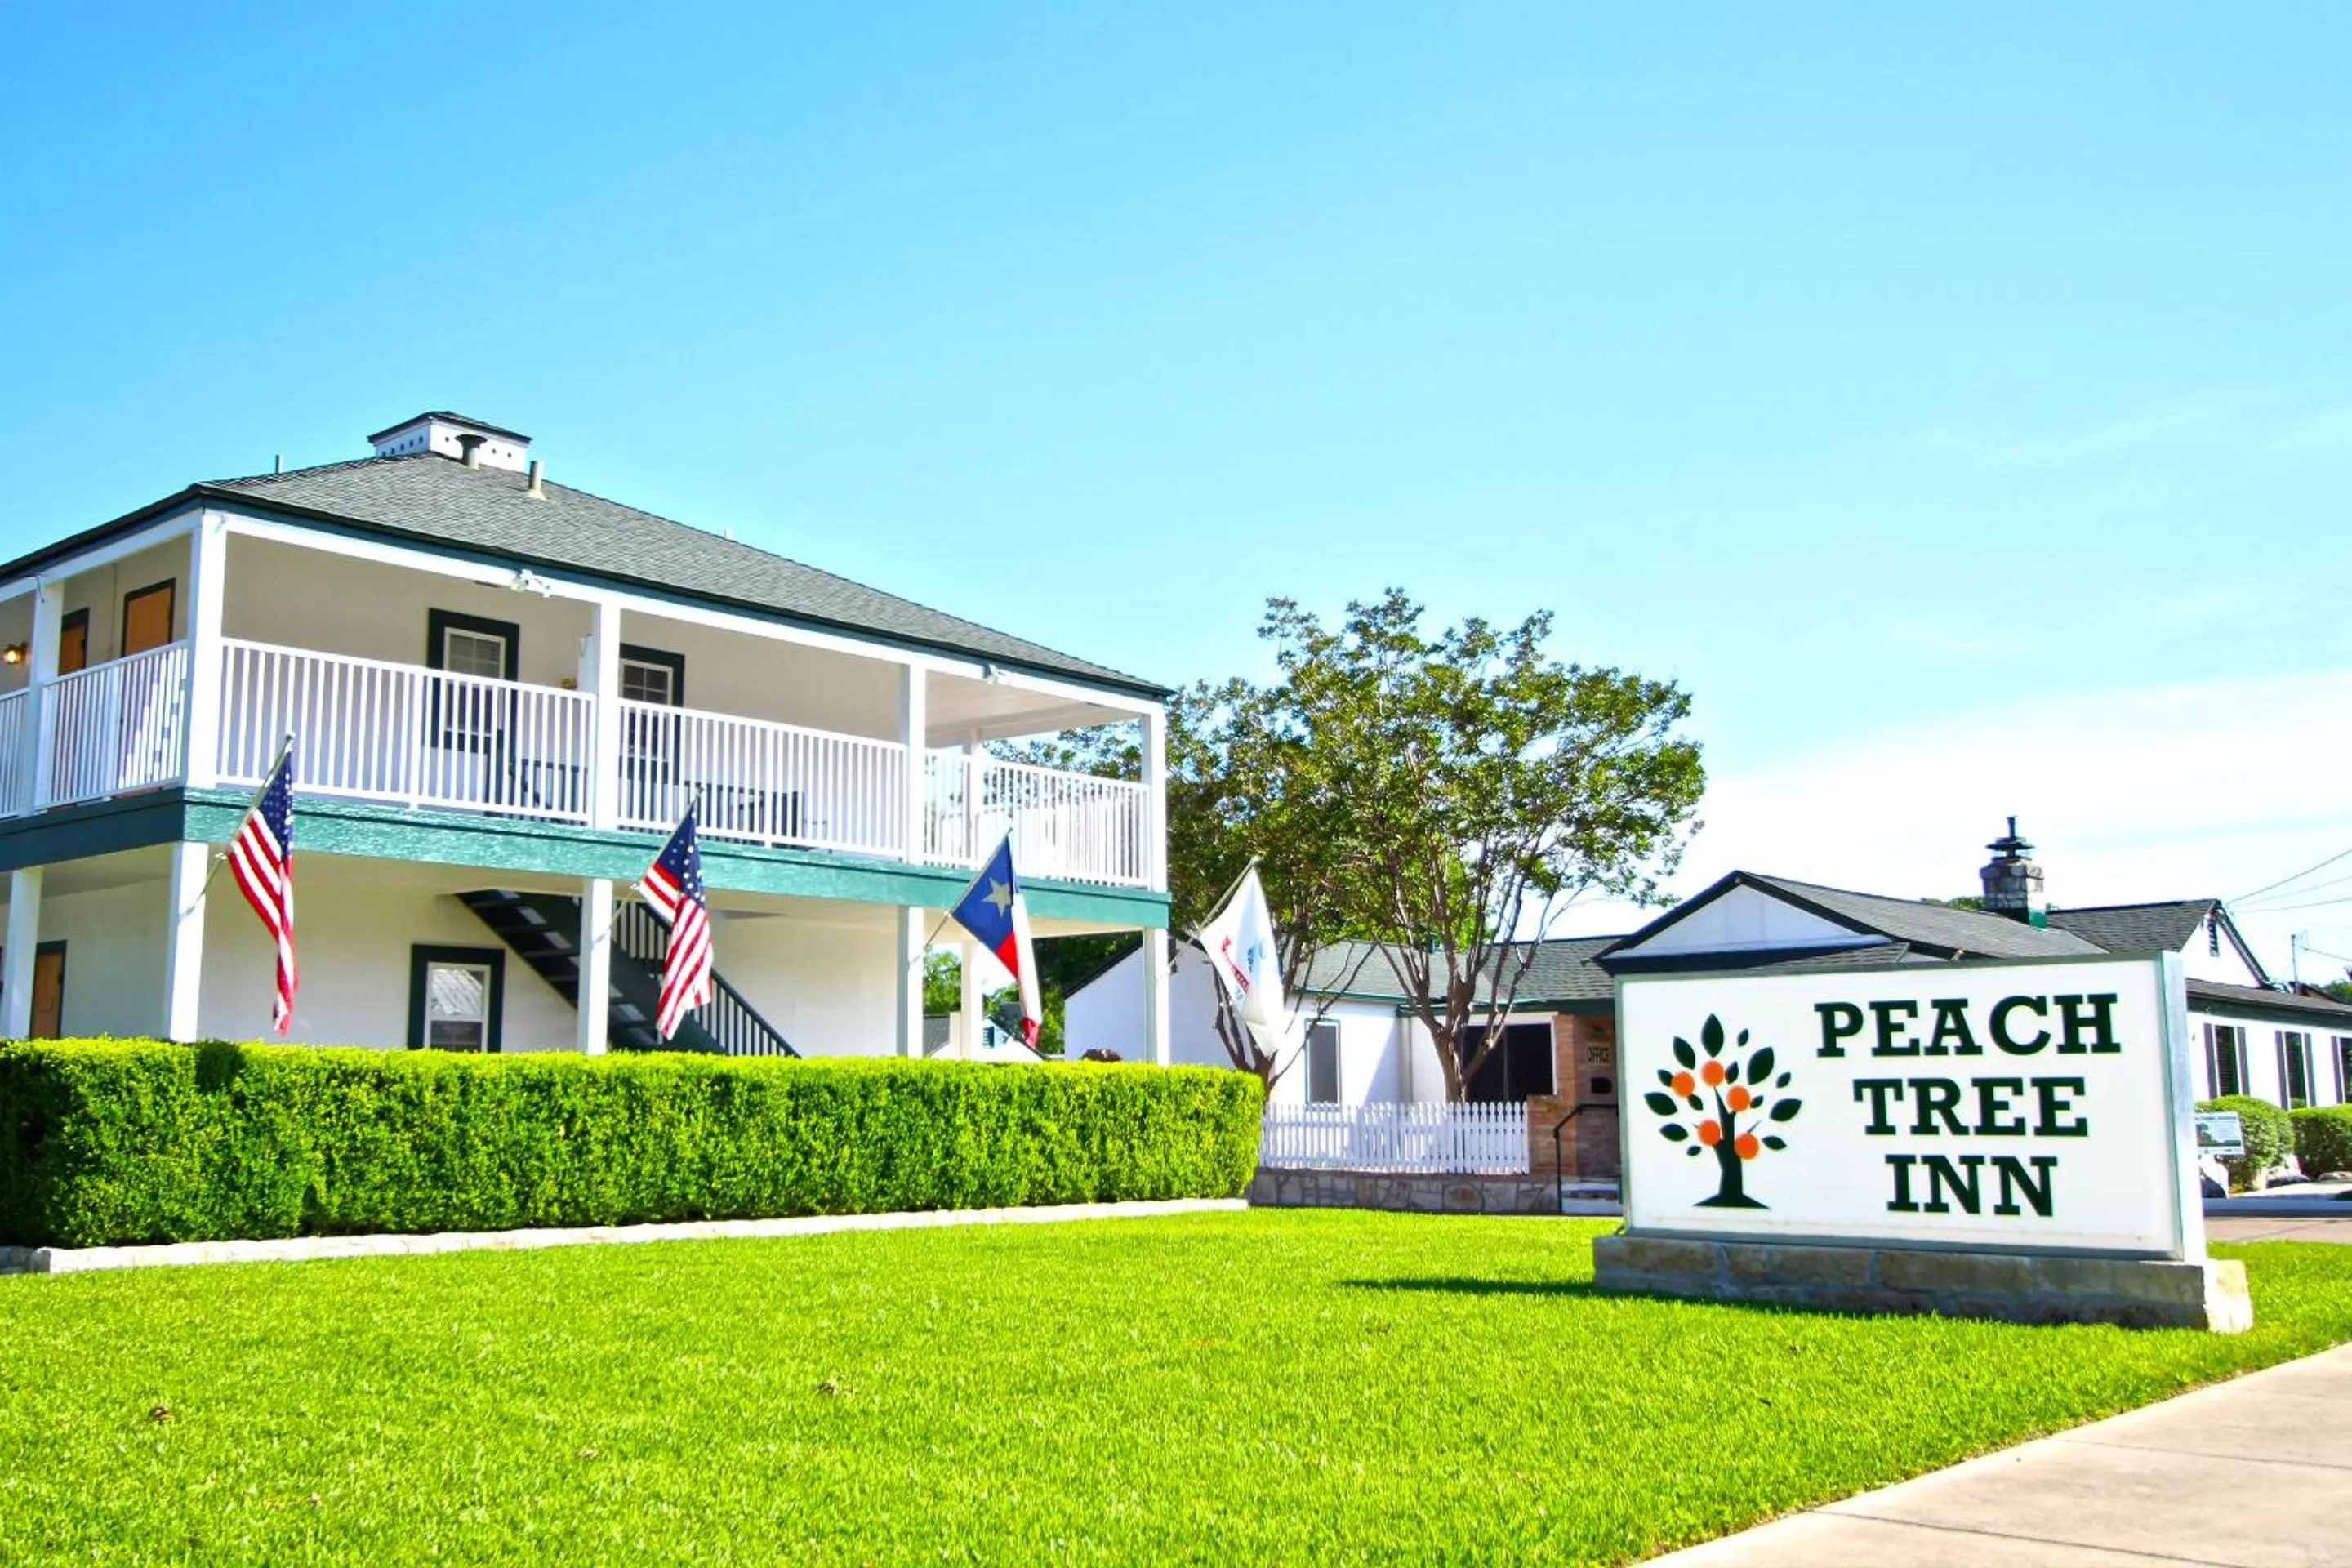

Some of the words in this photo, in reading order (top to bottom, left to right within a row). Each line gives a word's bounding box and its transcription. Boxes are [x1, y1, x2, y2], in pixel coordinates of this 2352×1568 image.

[1587, 1046, 1610, 1063] OFFICE
[1814, 993, 2121, 1058] PEACH
[1853, 1076, 2088, 1138] TREE
[1885, 1154, 2058, 1218] INN
